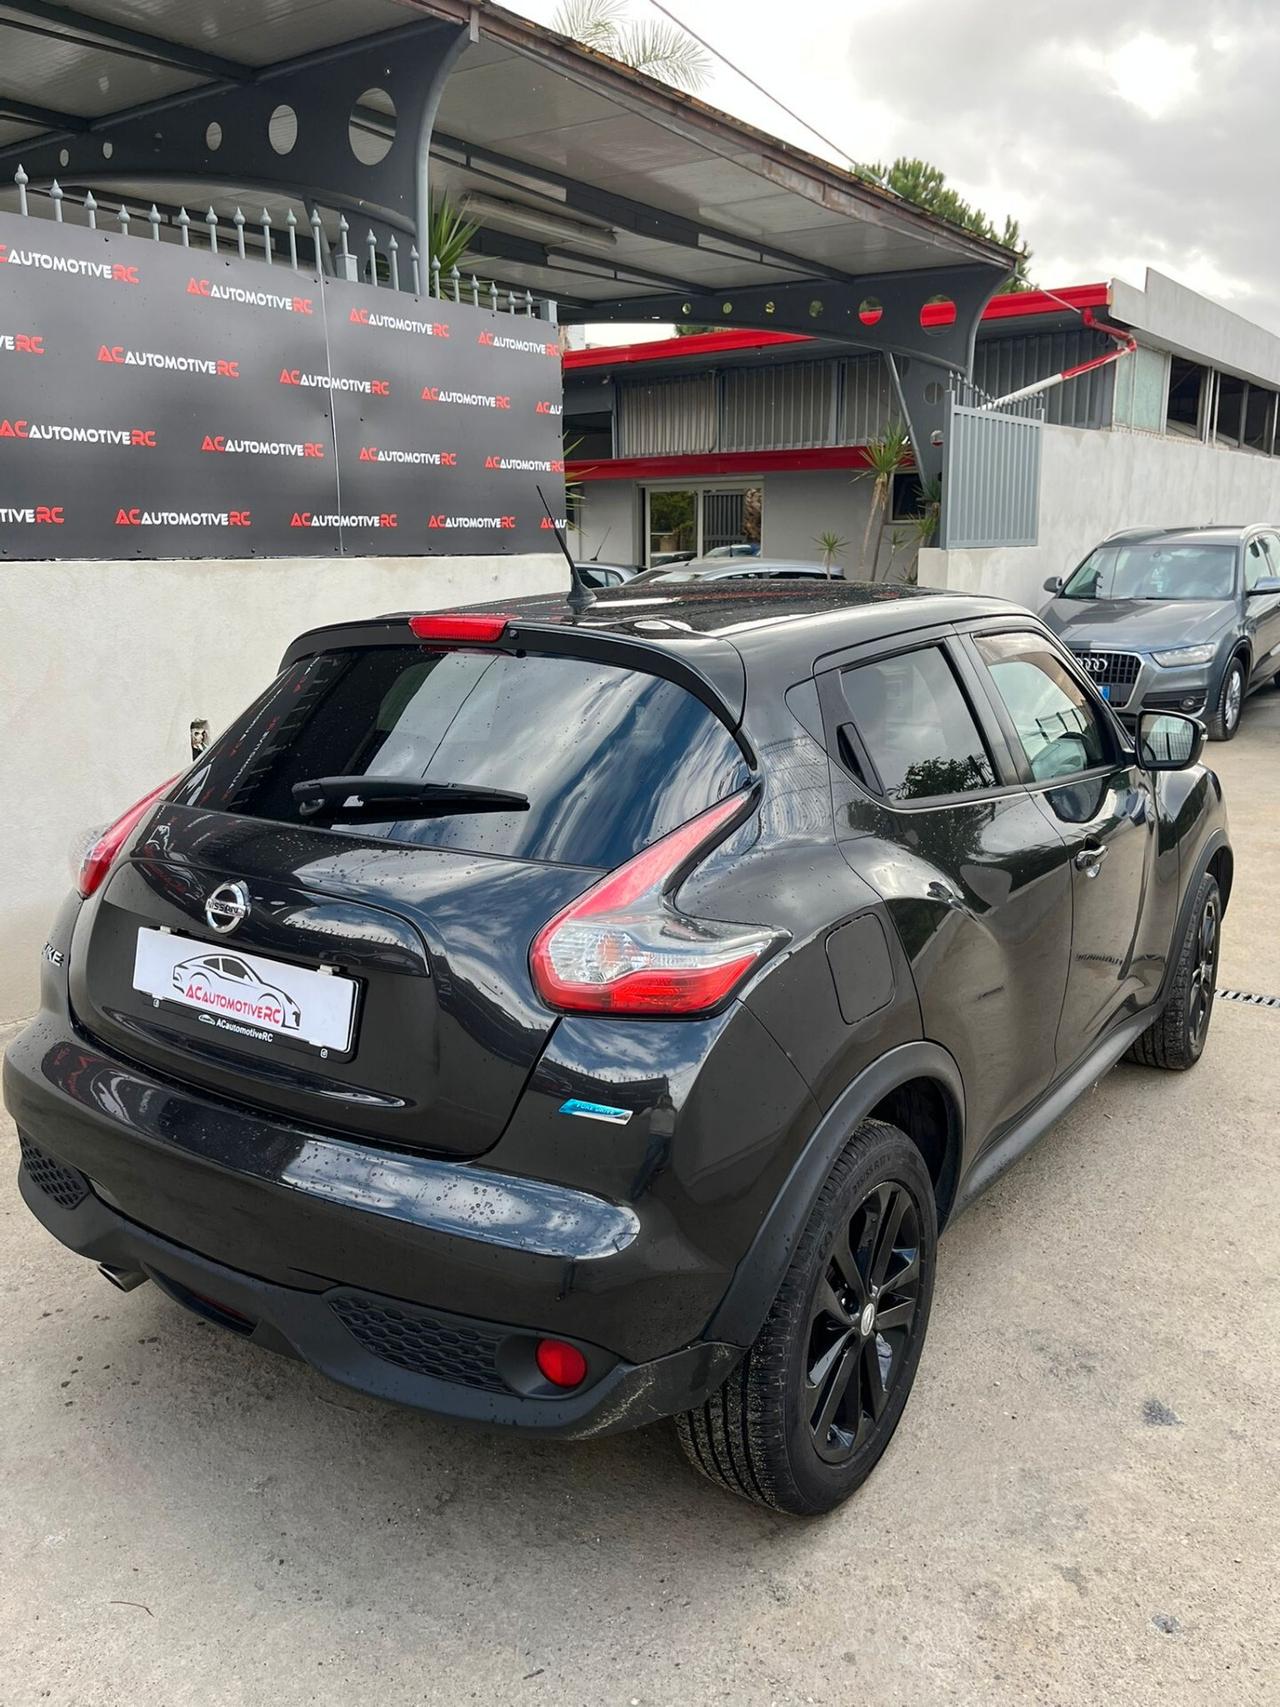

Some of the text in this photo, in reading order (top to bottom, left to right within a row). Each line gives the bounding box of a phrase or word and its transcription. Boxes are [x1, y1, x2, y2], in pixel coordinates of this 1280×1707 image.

[186, 277, 313, 314] ACAUTOMOTIVERC
[349, 307, 450, 338] ACAUTOMOTIVERC
[477, 331, 559, 356] ACAUTOMOTIVERC
[97, 345, 240, 377] ACAUTOMOTIVERC
[279, 367, 390, 396] ACAUTOMOTIVERC
[421, 386, 511, 410] ACAUTOMOTIVERC
[0, 419, 157, 448] ACAUTOMOTIVERC
[201, 435, 325, 458] ACAUTOMOTIVERC
[359, 446, 457, 467] ACAUTOMOTIVERC
[115, 507, 251, 527] ACAUTOMOTIVERC
[290, 512, 398, 528] ACAUTOMOTIVERC
[428, 514, 516, 529] ACAUTOMOTIVERC
[185, 984, 281, 1024] ACAUTOMOTIVERC
[216, 1018, 273, 1042] ACautomotiveRC
